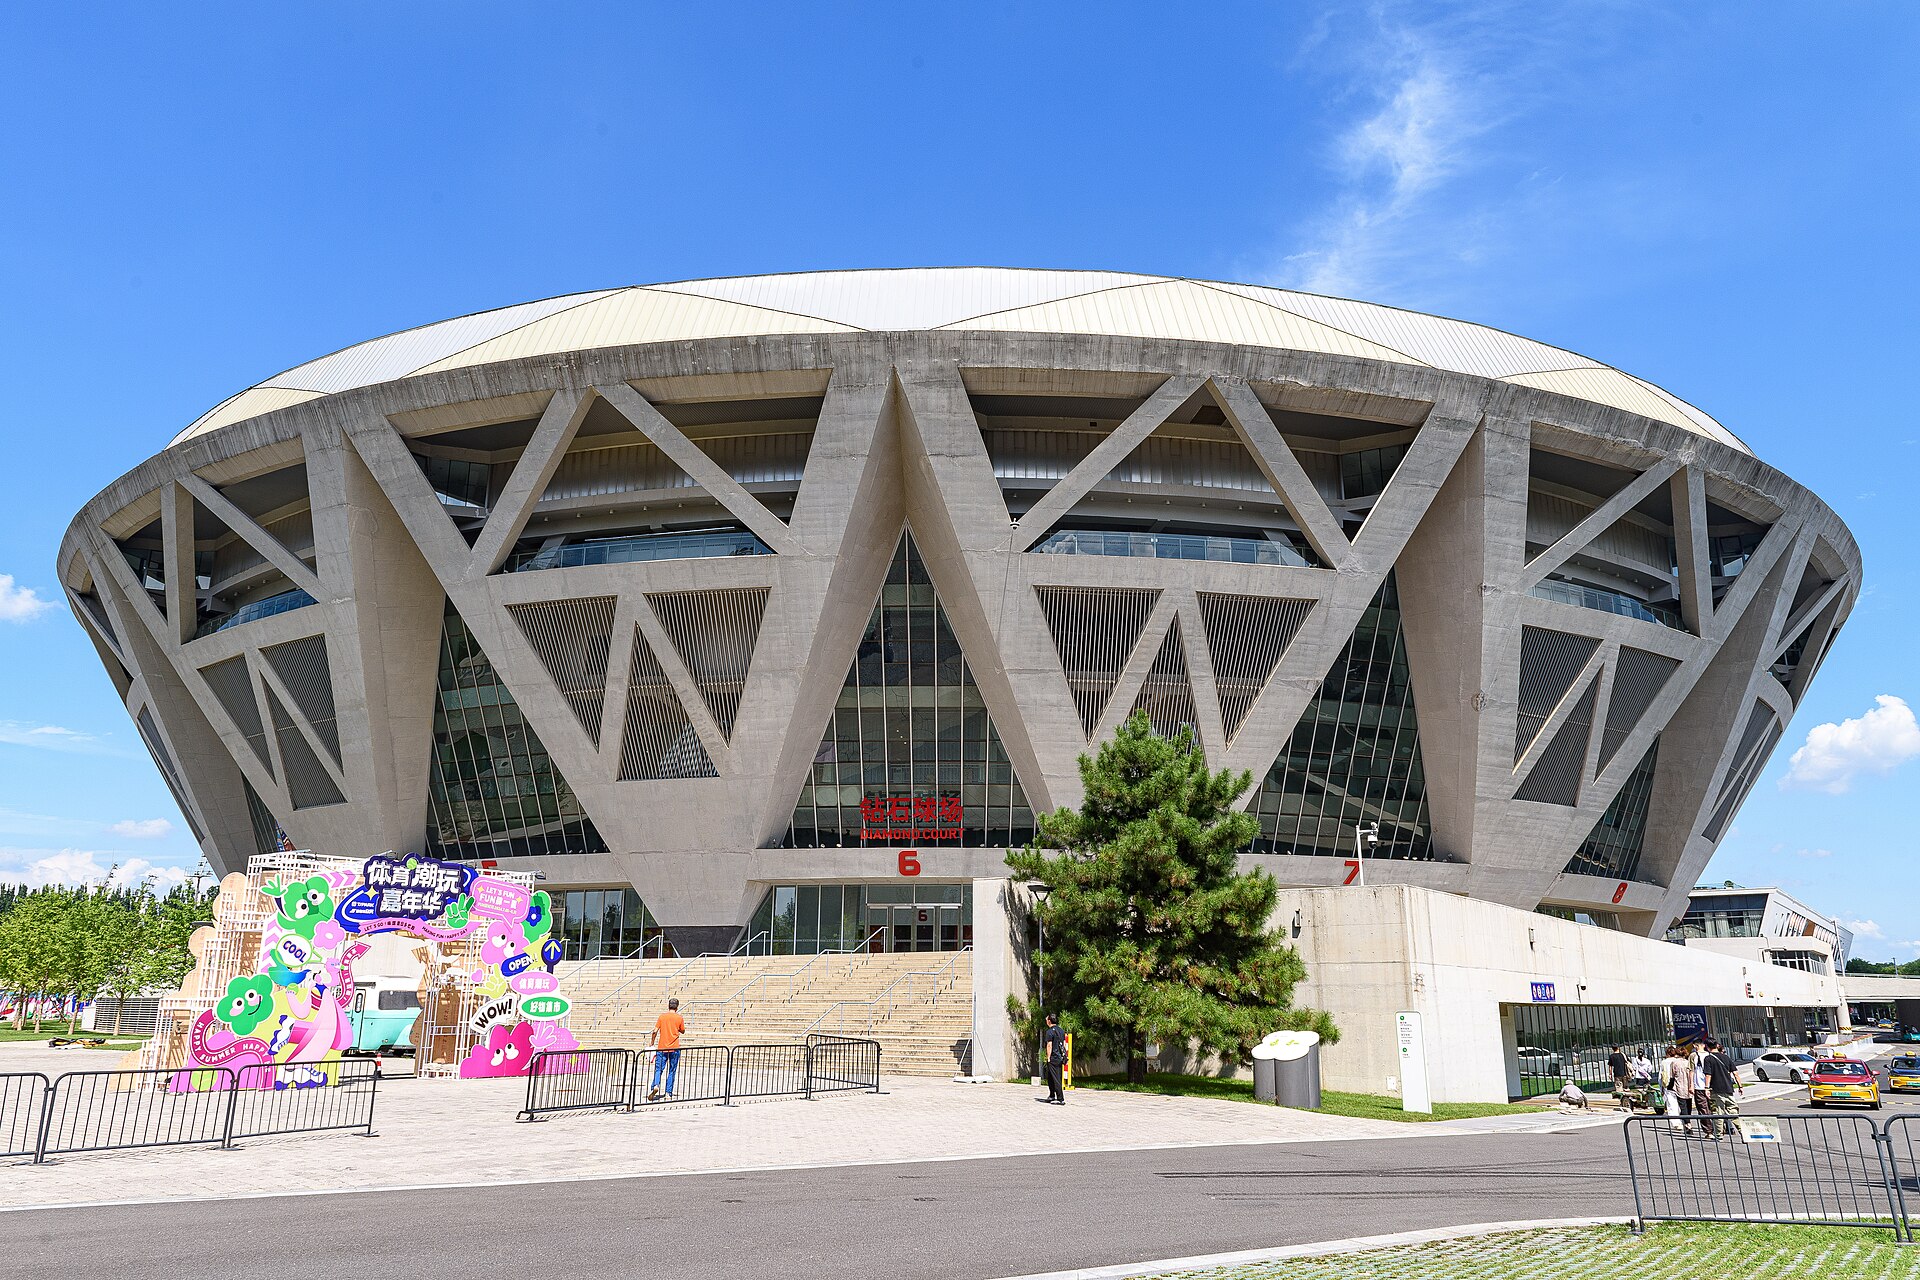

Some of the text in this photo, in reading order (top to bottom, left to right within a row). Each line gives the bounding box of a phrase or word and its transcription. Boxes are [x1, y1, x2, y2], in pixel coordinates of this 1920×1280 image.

[860, 796, 964, 823] 钻石球场
[861, 828, 965, 840] DIAMOND COURT
[898, 850, 921, 876] 6
[1342, 860, 1363, 885] 7
[367, 860, 461, 893] 体育潮玩
[379, 888, 442, 915] 嘉年华
[1611, 882, 1628, 904] 8
[918, 909, 928, 922] 6
[283, 940, 307, 964] COOL
[475, 998, 513, 1029] WOW!
[193, 1021, 204, 1052] HAPPY
[199, 1047, 236, 1063] SUMMER
